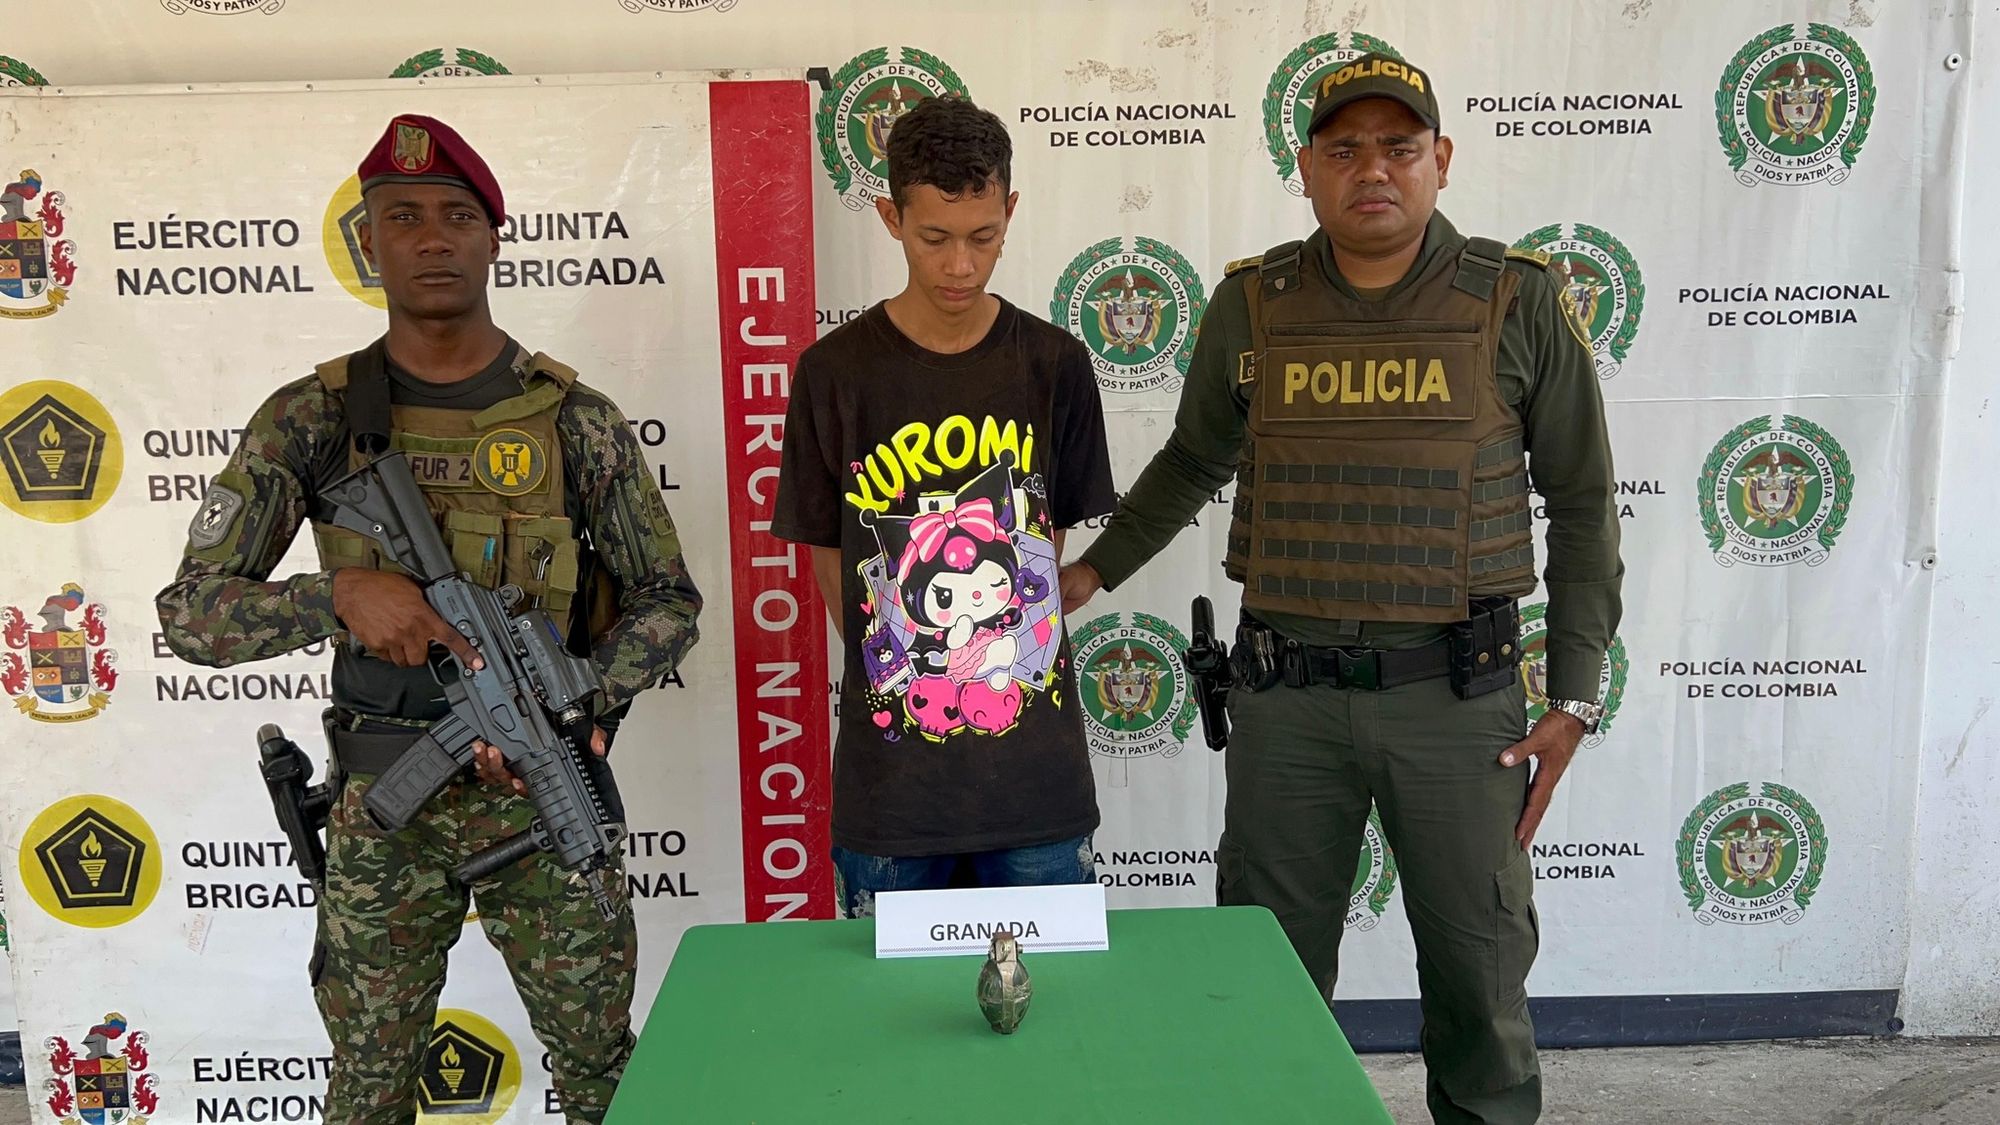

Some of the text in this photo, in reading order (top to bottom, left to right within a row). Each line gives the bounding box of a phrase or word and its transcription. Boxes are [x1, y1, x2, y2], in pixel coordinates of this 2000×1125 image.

[1337, 51, 1354, 60] DE
[888, 65, 906, 75] DE
[1322, 59, 1425, 98] POLICIA
[1793, 42, 1812, 51] DE
[1824, 48, 1857, 113] COLOMBIA
[1021, 102, 1236, 122] POLICÍA NACIONAL
[1467, 92, 1683, 112] POLICÍA NACIONAL
[1050, 129, 1205, 147] DE COLOMBIA
[1496, 119, 1652, 137] DE COLOMBIA
[1797, 127, 1850, 167] NACIONAL
[1795, 163, 1835, 183] PATRIA
[113, 214, 299, 249] EJÉRCITO
[117, 265, 313, 295] NACIONAL
[494, 257, 665, 288] BRIGADA
[1560, 242, 1625, 310] DE COLOMBIA
[1122, 255, 1139, 264] DE
[1151, 262, 1188, 323] COLOMBIA
[1679, 283, 1890, 303] POLICÍA NACIONAL
[1707, 309, 1857, 326] DE COLOMBIA
[1130, 338, 1182, 376] NACIONAL
[1129, 371, 1169, 390] PATRIA
[1284, 358, 1451, 404] POLICIA
[459, 458, 471, 481] 2
[1770, 433, 1785, 441] DE
[1797, 438, 1833, 499] COLOMBIA
[1771, 513, 1827, 549] NACIONAL
[1770, 545, 1812, 563] PATRIA
[1120, 629, 1136, 638] DE
[1148, 635, 1184, 693] COLOMBIA
[1660, 657, 1867, 677] POLICÍA NACIONAL
[1687, 683, 1838, 699] DE COLOMBIA
[1128, 705, 1180, 741] NACIONAL
[1128, 738, 1167, 755] PATRIA
[756, 662, 809, 921] NACION
[1748, 799, 1764, 807] DE
[1776, 804, 1808, 861] COLOMBIA
[1532, 843, 1645, 858] NACIONAL
[1099, 873, 1196, 887] OLOMBIA
[1535, 865, 1615, 880] LOMBIA
[186, 884, 317, 908] BRIGAD
[1749, 874, 1803, 907] NACIONAL
[1749, 905, 1789, 921] PATRIA
[930, 921, 1040, 942] GRANADA
[193, 1051, 333, 1082] EJÉRCIT
[197, 1095, 325, 1123] NACION
